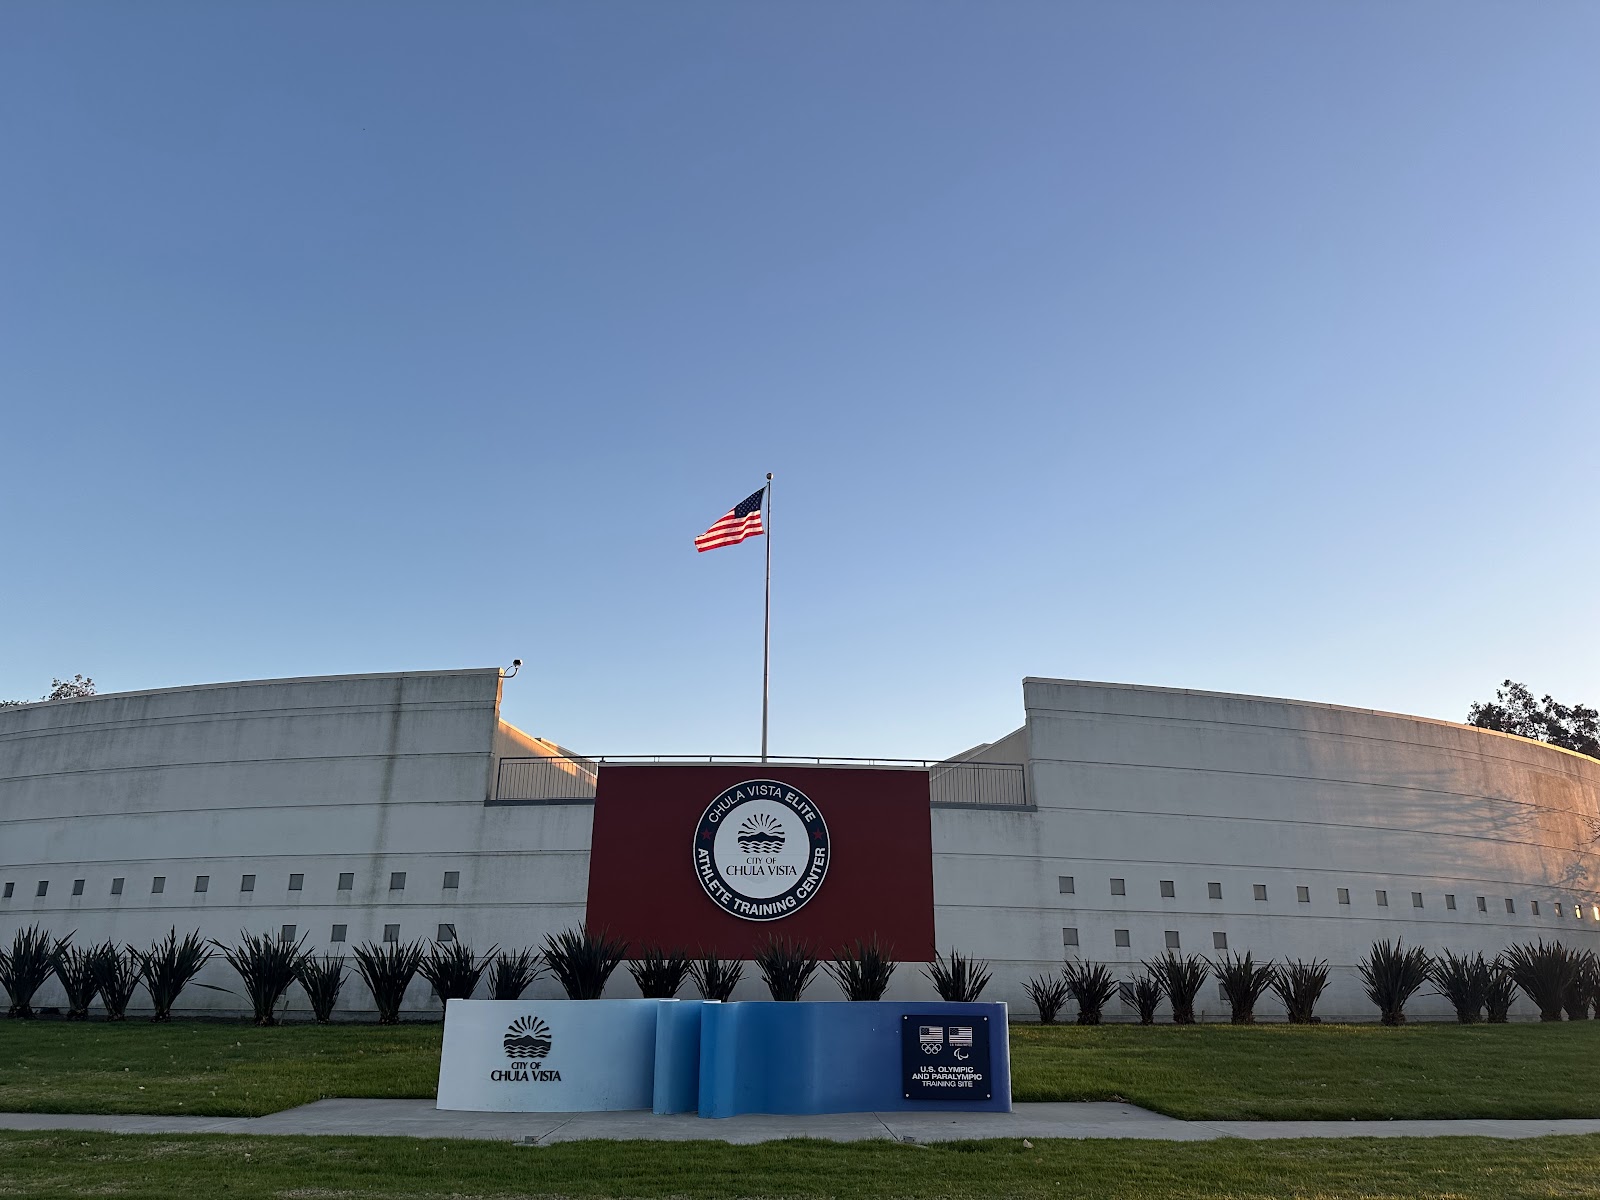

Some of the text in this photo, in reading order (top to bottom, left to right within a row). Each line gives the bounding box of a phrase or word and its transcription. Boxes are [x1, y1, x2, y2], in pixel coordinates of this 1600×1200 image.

[708, 785, 817, 823] CHULA VISTA ELITE
[746, 857, 777, 865] CITY OF
[726, 865, 797, 876] CHULA VISTA
[698, 847, 826, 916] ATHLETE TRAINING CENTER
[511, 1061, 542, 1070] CITY OF
[920, 1065, 974, 1073] U.S. OLYMPIC
[490, 1069, 562, 1082] CHULA VISTA
[931, 1073, 983, 1081] PARALYMPIC
[957, 1080, 974, 1088] SITE
